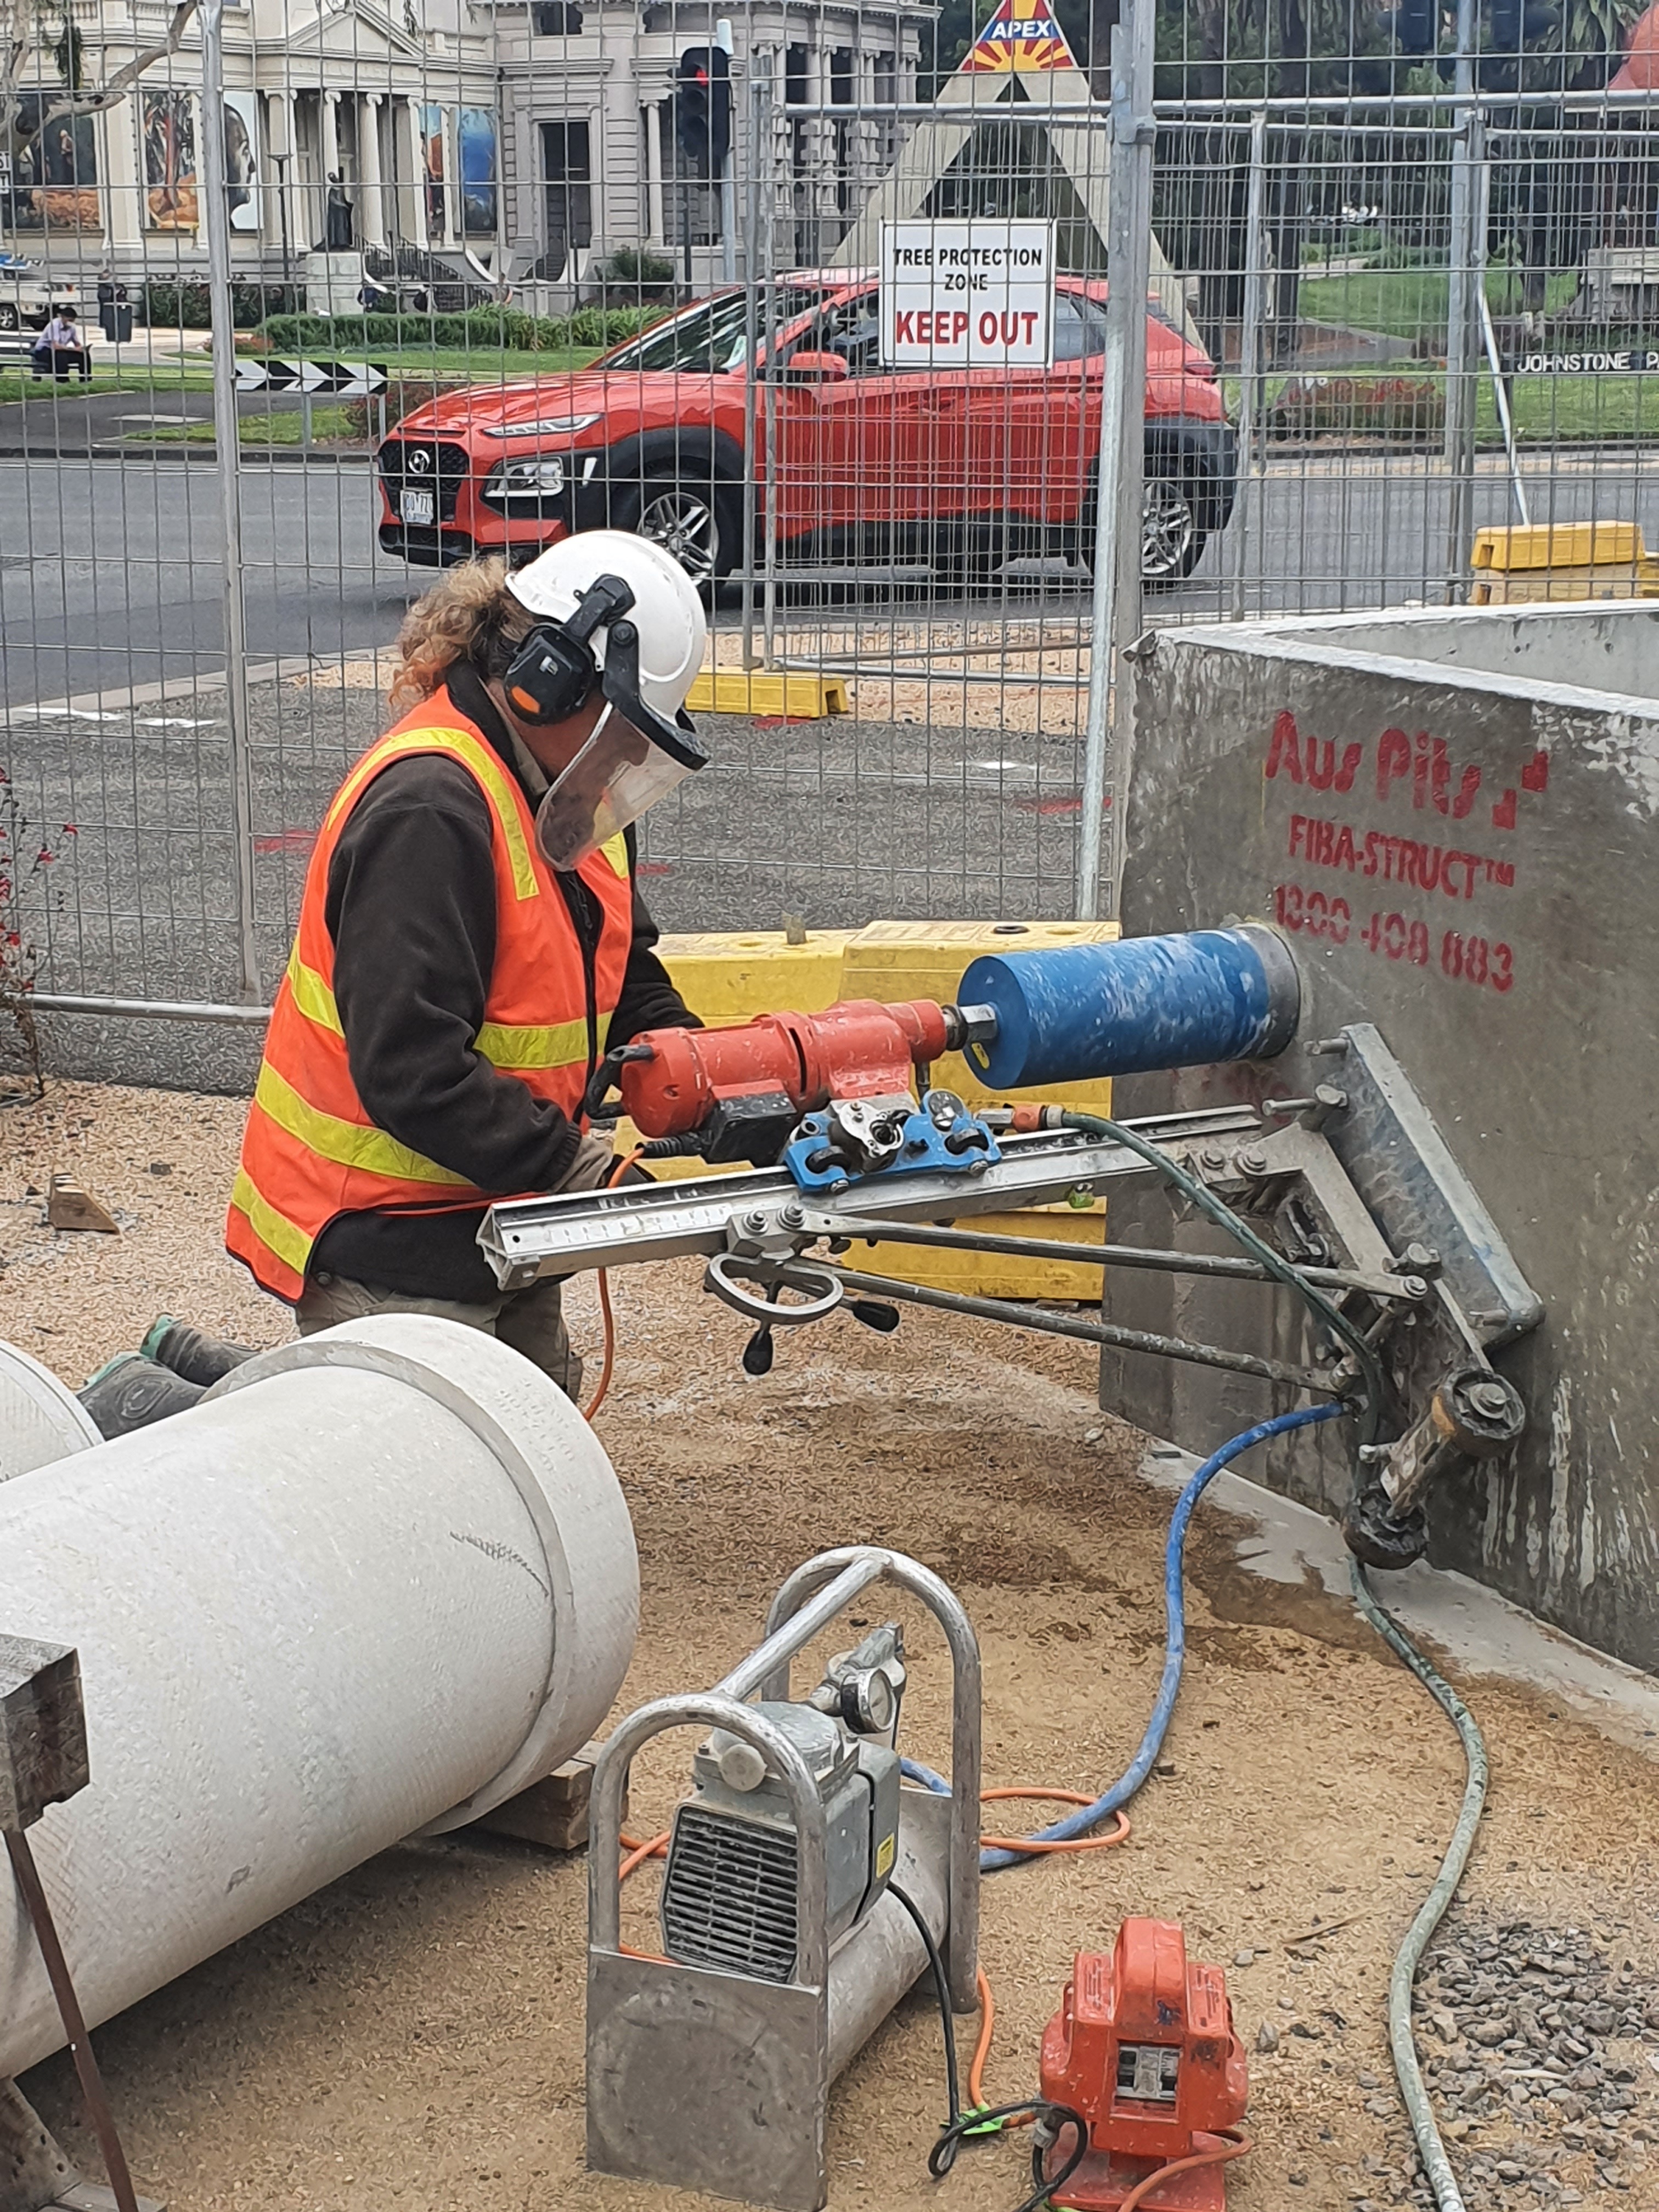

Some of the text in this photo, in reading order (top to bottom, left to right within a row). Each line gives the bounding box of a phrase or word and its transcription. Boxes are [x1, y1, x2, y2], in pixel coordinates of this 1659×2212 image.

[991, 19, 1051, 39] APEX
[894, 249, 1042, 266] TREE PROTECTION
[944, 274, 988, 291] ZONE
[896, 311, 1038, 346] KEEP OUT
[1517, 352, 1659, 373] JOHNSTONE P
